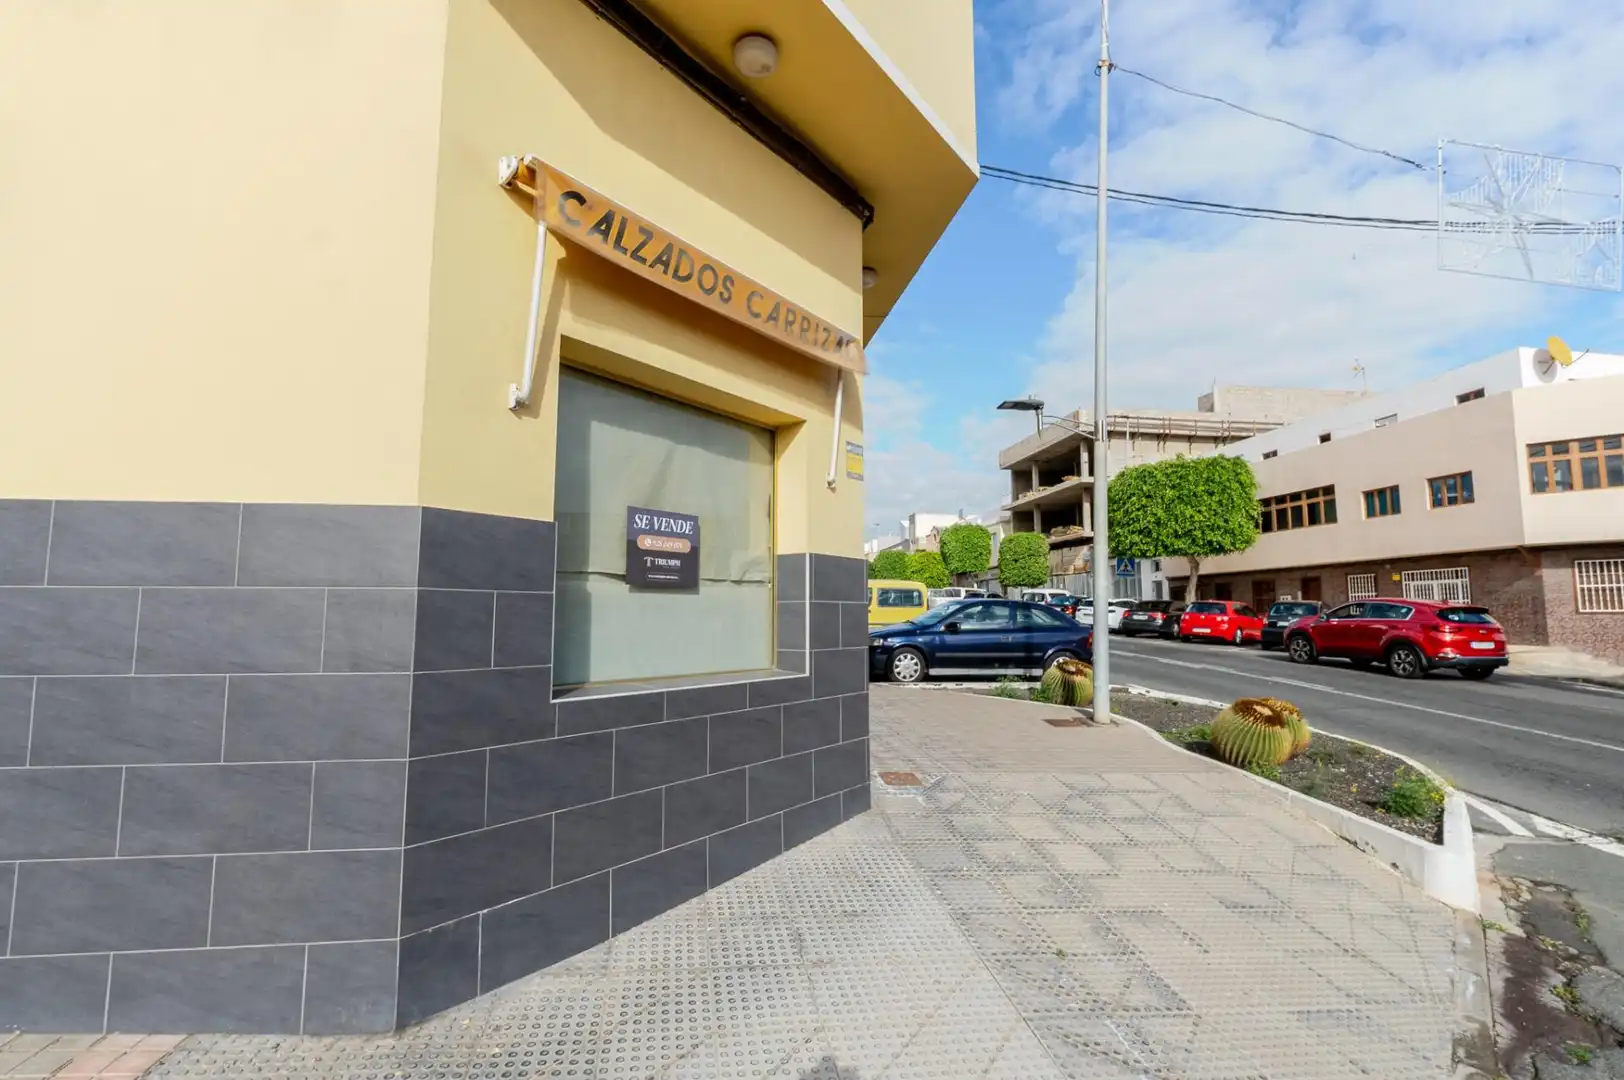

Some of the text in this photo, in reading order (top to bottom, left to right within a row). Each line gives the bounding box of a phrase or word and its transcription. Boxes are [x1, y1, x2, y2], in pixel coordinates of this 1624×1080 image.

[558, 190, 735, 305] CALZADOS
[633, 513, 694, 535] SE VENDE
